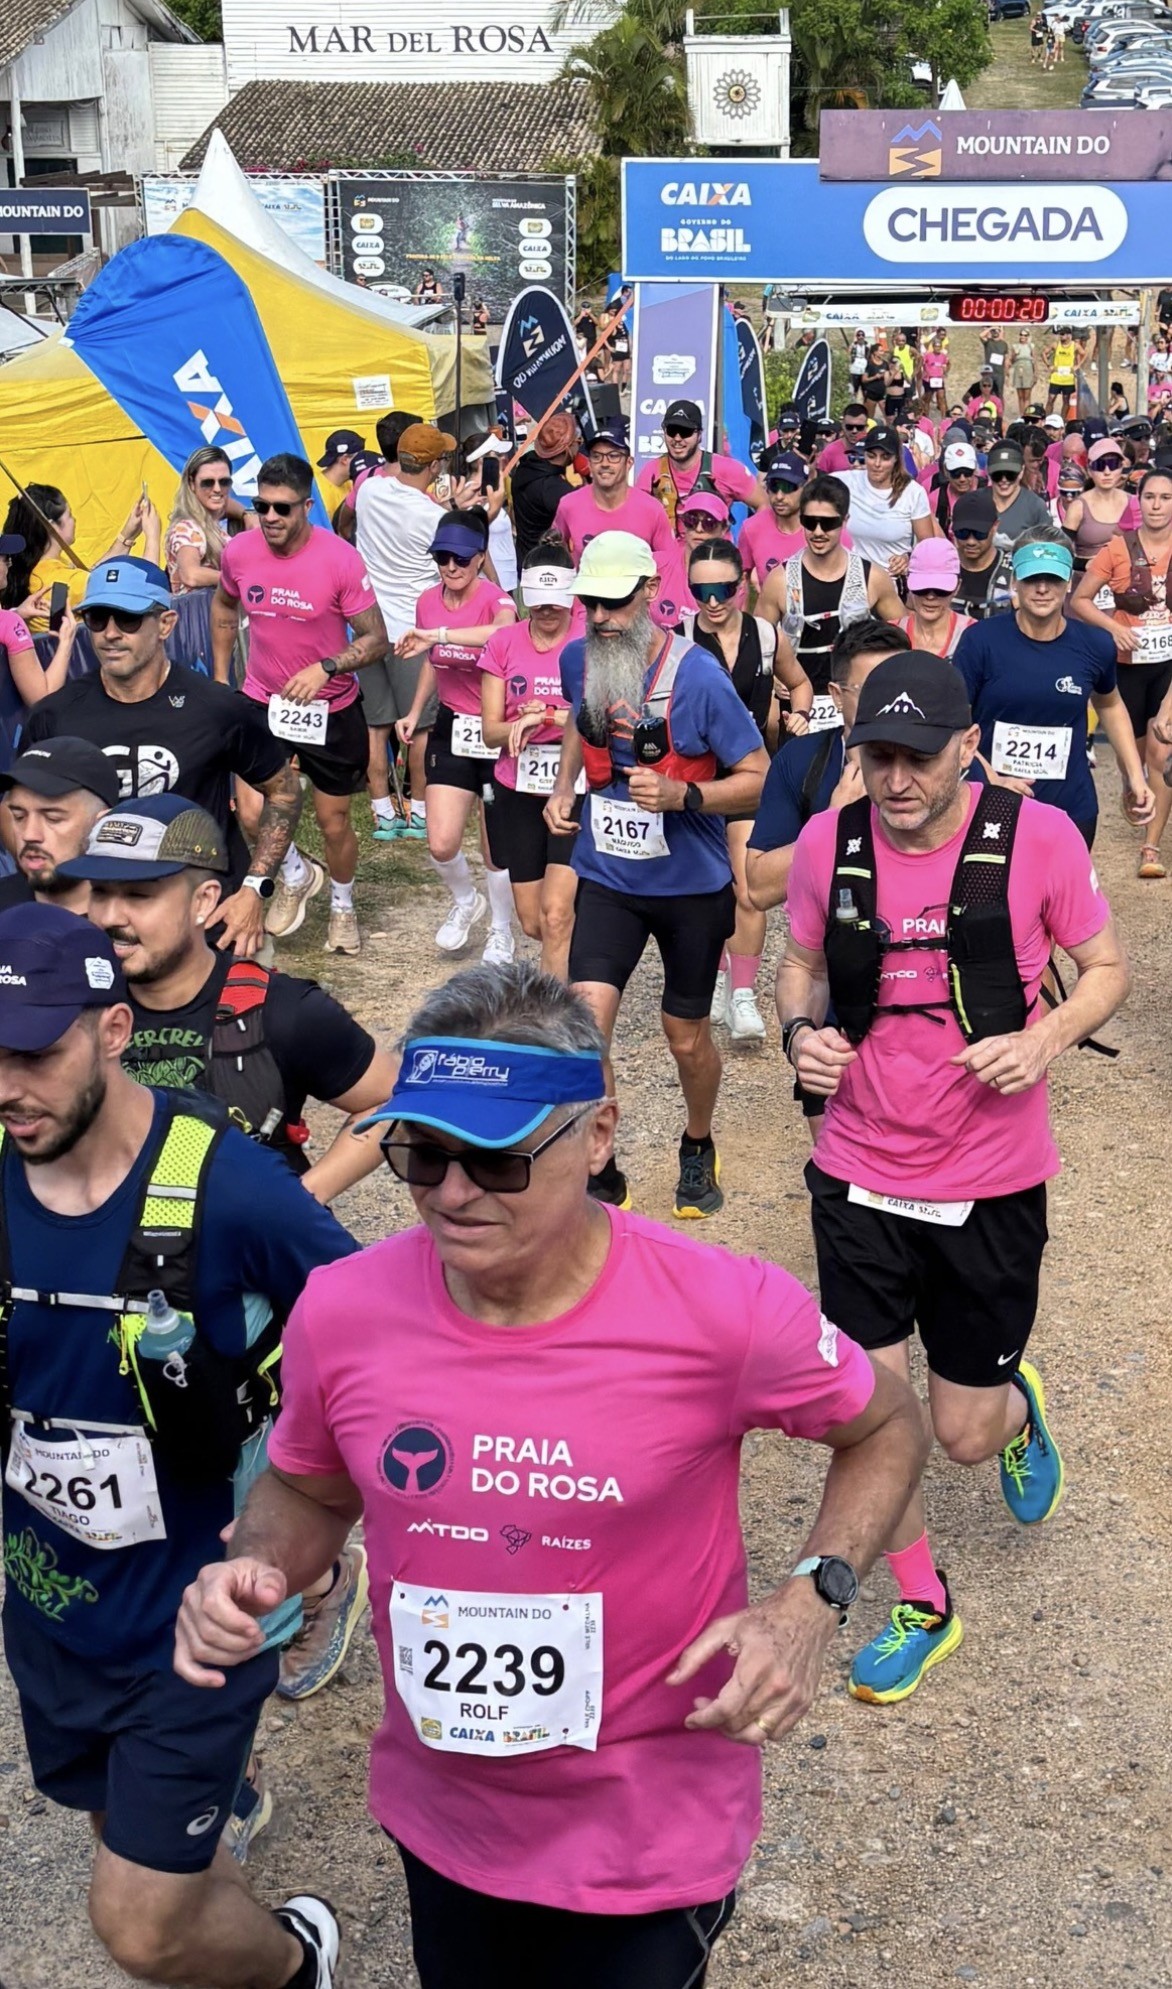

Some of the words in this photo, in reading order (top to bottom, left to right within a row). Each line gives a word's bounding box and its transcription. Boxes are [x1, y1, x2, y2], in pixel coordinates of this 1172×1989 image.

[286, 25, 377, 53] MAR
[387, 32, 442, 53] DEL
[450, 25, 554, 53] ROSA
[957, 136, 1070, 155] MOUNTAIN
[1076, 136, 1110, 155] DO
[660, 182, 752, 206] CAIXA
[64, 205, 84, 218] DO
[888, 206, 1103, 242] CHEGADA
[356, 241, 380, 249] CAIXA
[661, 228, 752, 252] BRASIL
[523, 245, 548, 253] CAIXA
[961, 298, 1044, 319] 00:00:20
[1064, 309, 1097, 317] CAIXA
[271, 587, 300, 599] PRAIA
[270, 596, 286, 605] DO
[286, 598, 314, 611] ROSA
[439, 649, 452, 659] DO
[452, 651, 477, 661] ROSA
[534, 676, 562, 686] PRAI
[533, 687, 550, 696] DO
[280, 709, 323, 728] 2243
[810, 705, 837, 720] 222
[1005, 740, 1057, 760] 2214
[529, 760, 560, 777] 210
[603, 816, 650, 840] 2167
[902, 918, 946, 935] PRAI
[92, 1449, 110, 1459] DO
[472, 1434, 574, 1467] PRAIA
[25, 1460, 122, 1511] 2261
[471, 1467, 520, 1495] DO
[528, 1471, 625, 1502] ROSA
[50, 1505, 90, 1526] TIAGO
[541, 1535, 592, 1550] RAÍZES
[458, 1606, 529, 1619] MOUNTAIN
[531, 1608, 552, 1620] DO
[423, 1639, 565, 1697] 2239
[460, 1702, 509, 1720] ROLF
[449, 1727, 495, 1742] CAIXA
